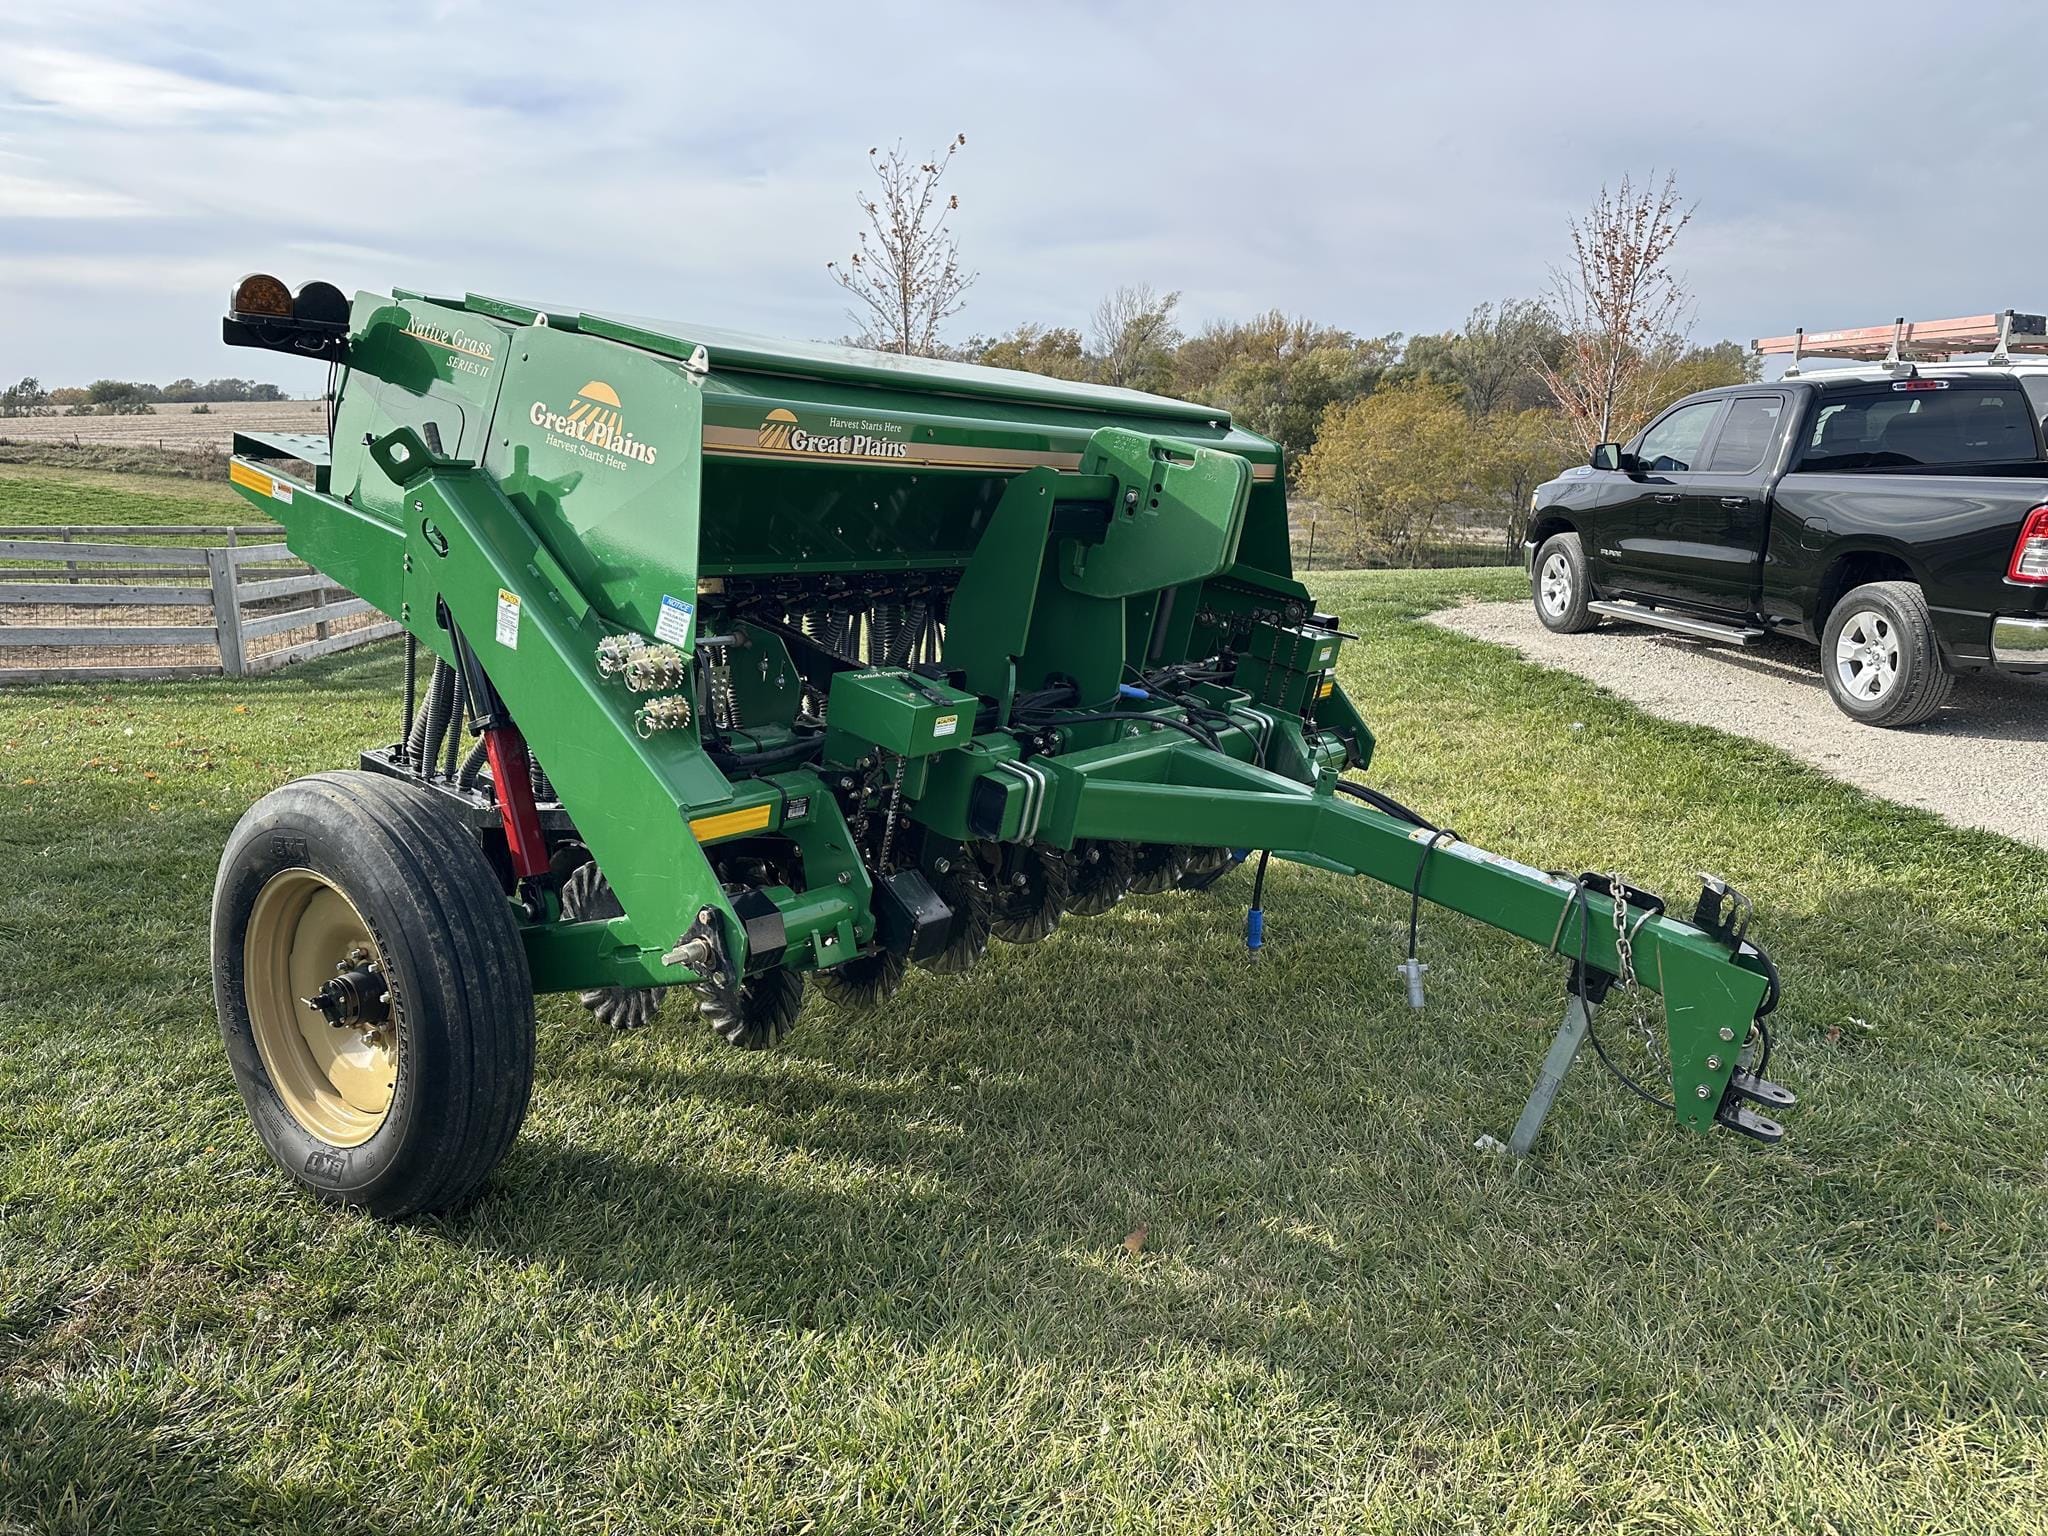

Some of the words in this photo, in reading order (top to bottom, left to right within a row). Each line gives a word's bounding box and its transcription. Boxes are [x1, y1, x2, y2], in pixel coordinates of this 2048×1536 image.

[404, 314, 449, 344] Native
[452, 329, 492, 356] Grass
[446, 355, 479, 374] SERIES
[480, 366, 489, 378] II
[529, 401, 588, 441] Great
[591, 420, 657, 465] Plains
[829, 417, 859, 430] Harvest
[861, 420, 882, 431] Starts
[884, 422, 902, 433] Here
[545, 433, 578, 454] Harvest
[578, 445, 604, 463] Starts
[605, 454, 627, 471] Here
[791, 429, 848, 453] Great
[851, 434, 907, 457] Plains
[668, 598, 690, 611] NOTICE
[305, 1153, 344, 1178] BKT
